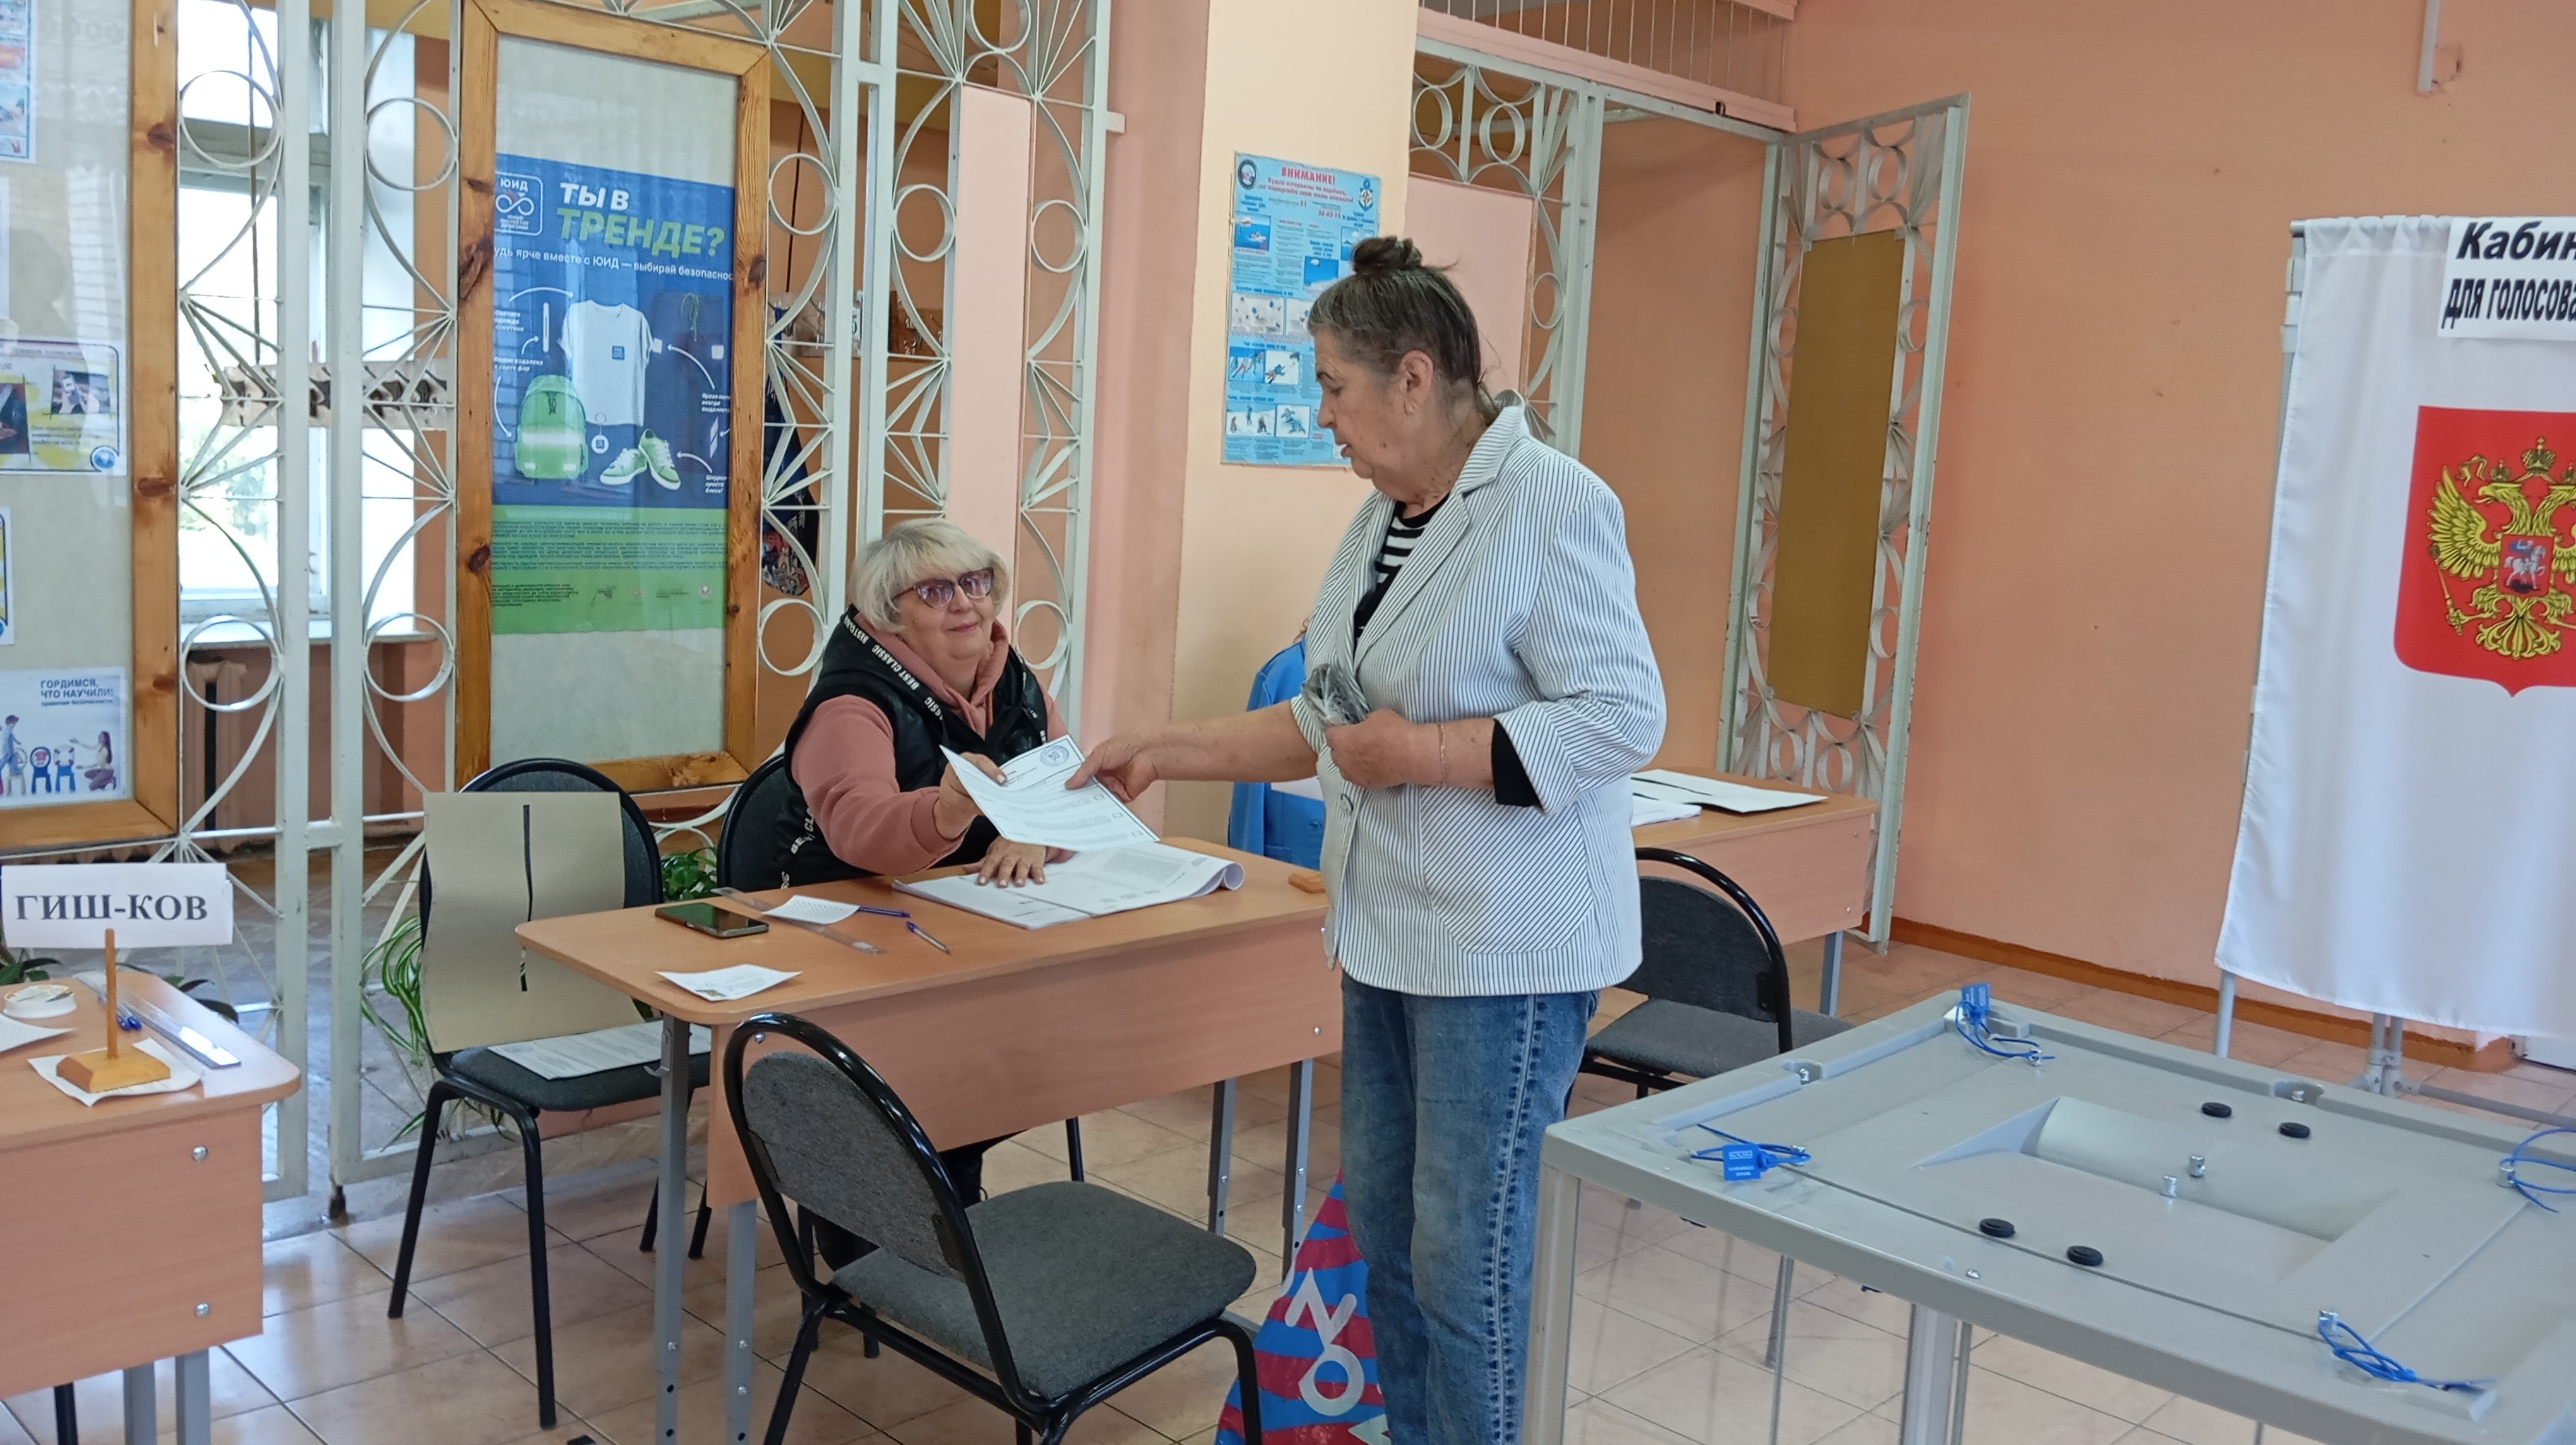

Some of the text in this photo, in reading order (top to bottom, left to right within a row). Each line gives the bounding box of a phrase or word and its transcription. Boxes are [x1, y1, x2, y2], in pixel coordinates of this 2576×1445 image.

[500, 177, 528, 192] ЮИД
[1281, 167, 1335, 185] ВНИМАНИЕ!
[560, 183, 629, 211] ТЫ В
[557, 208, 725, 259] ТРЕНДЕ?
[494, 246, 513, 258] удь
[516, 249, 541, 260] ярче
[544, 252, 581, 264] вместе
[593, 256, 619, 270] ЮИД
[633, 262, 676, 276] выбирай
[2440, 278, 2485, 330] для
[871, 644, 920, 690] BEST CLASSIC
[40, 678, 98, 689] ГОРДИМСЯ,
[40, 688, 114, 699] ЧТО НАУЧИЛИ!
[15, 894, 208, 921] ГИШ-КОВ
